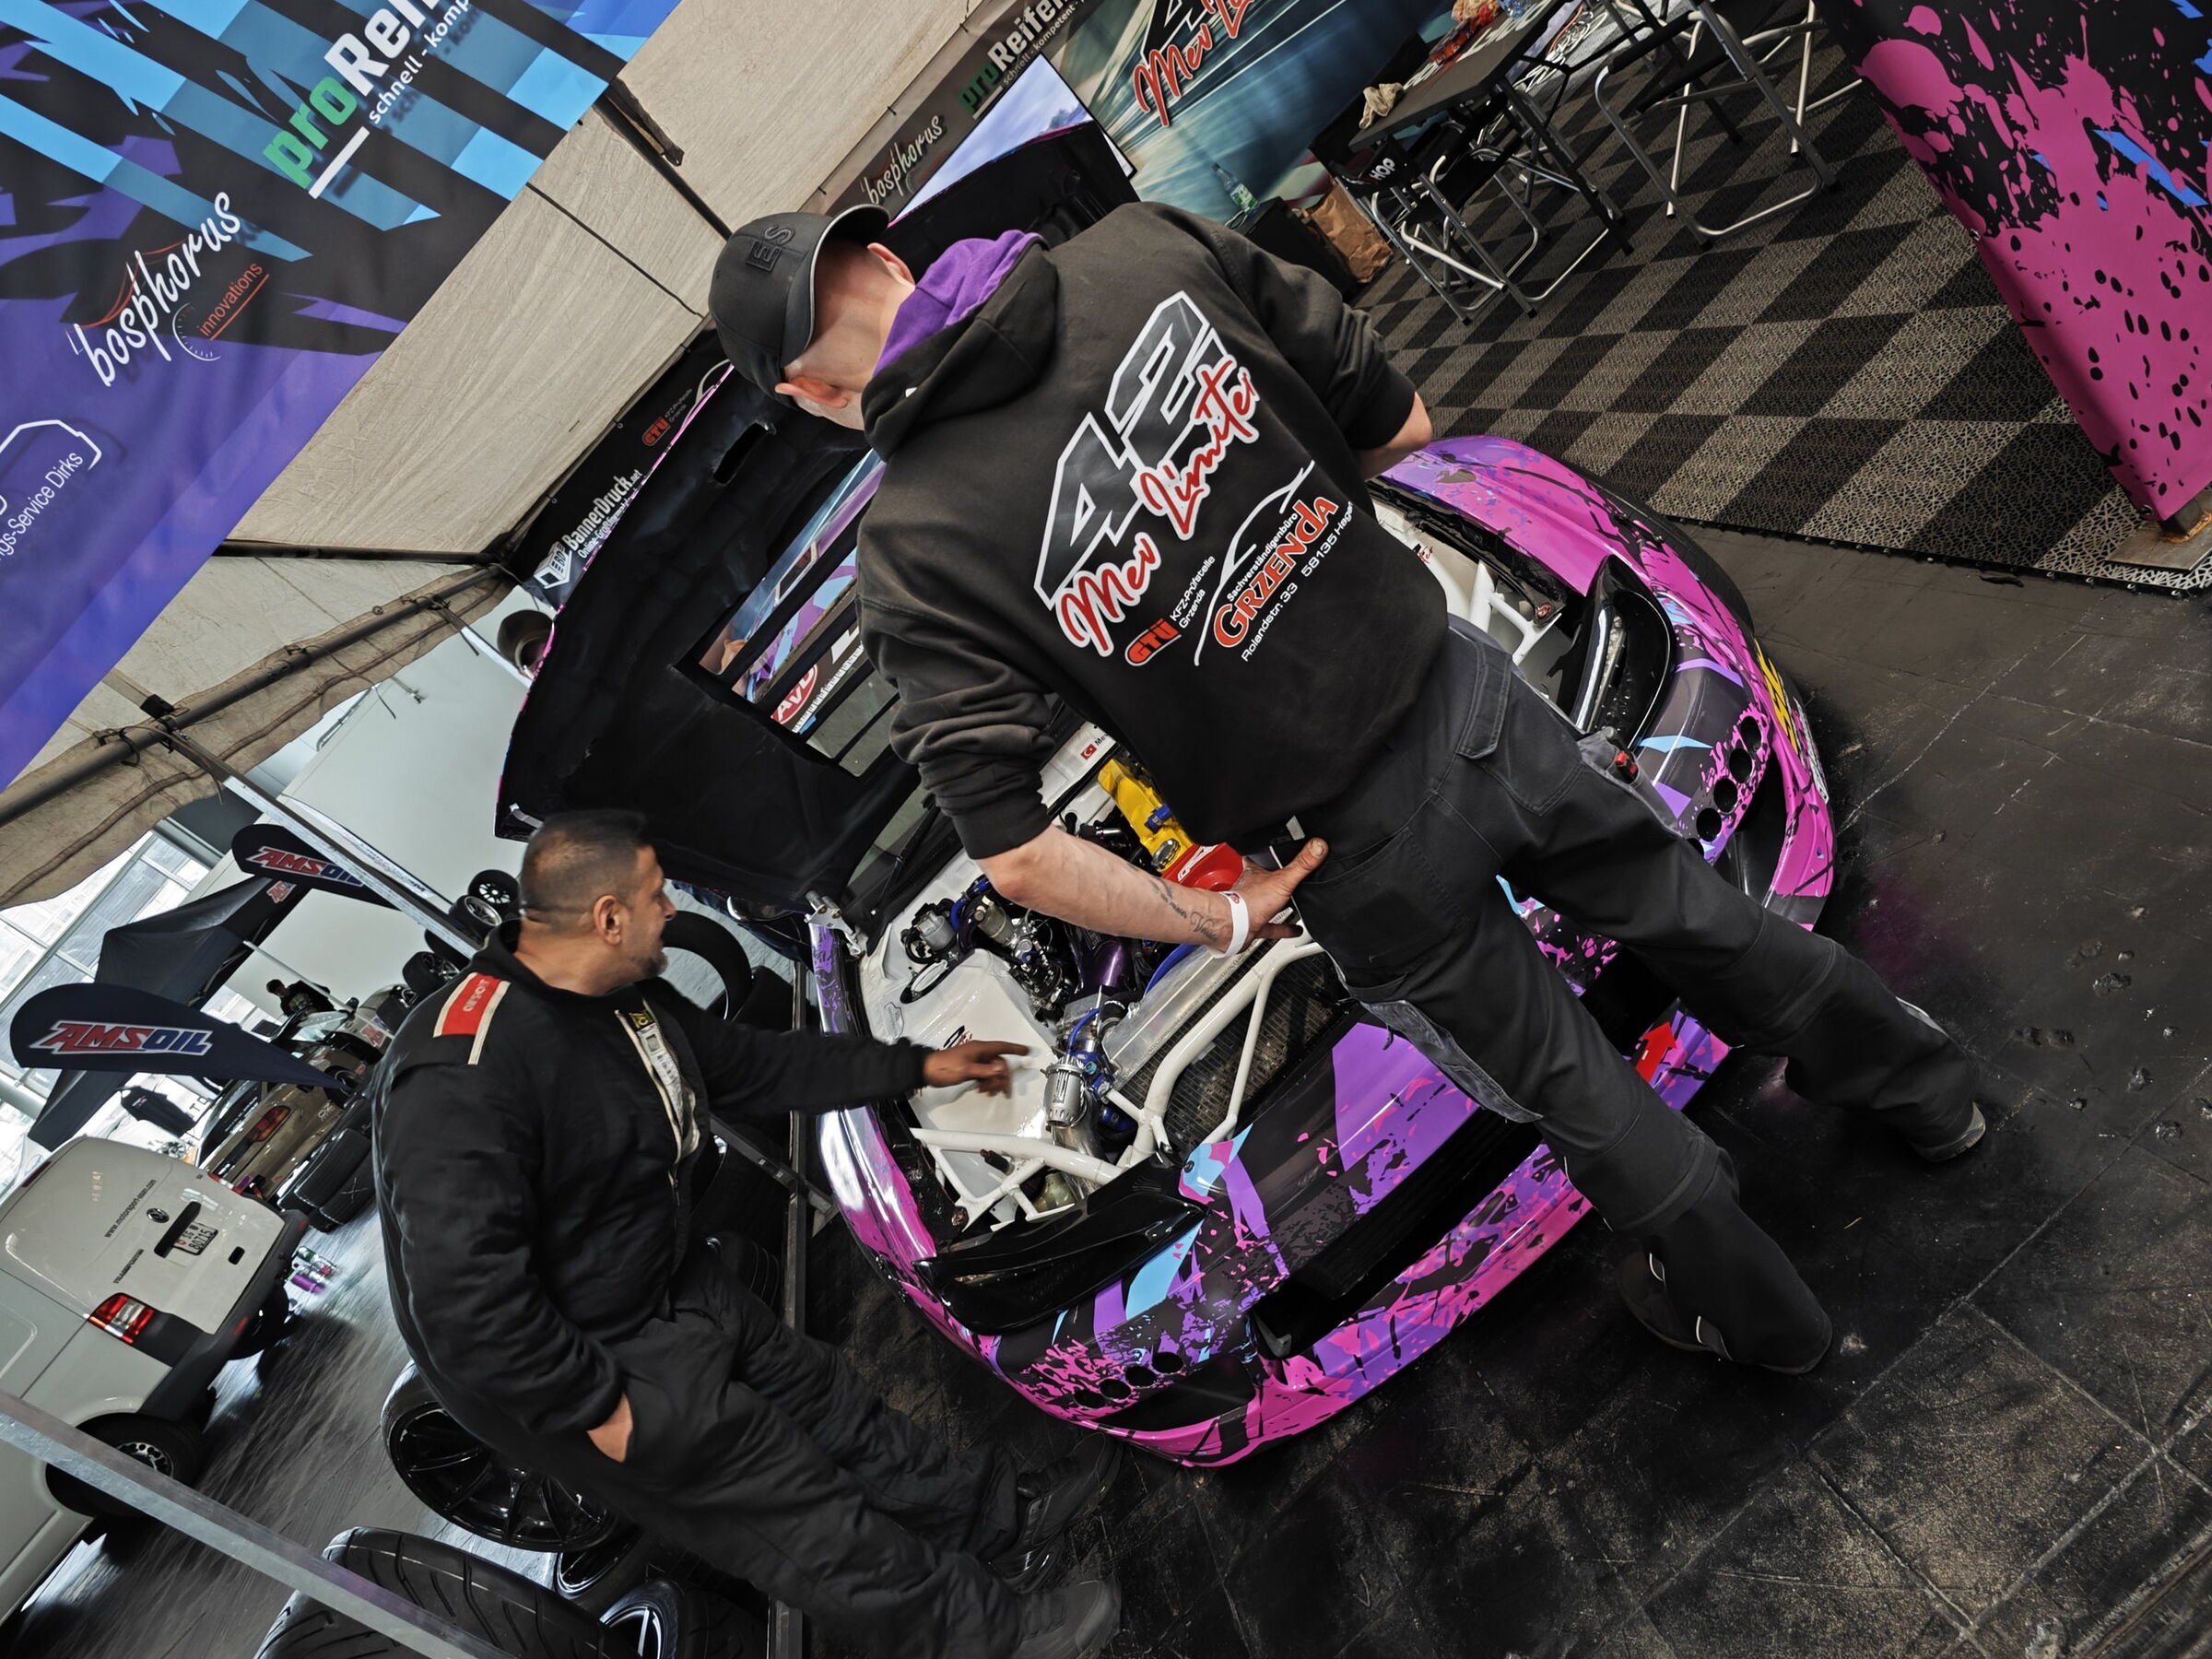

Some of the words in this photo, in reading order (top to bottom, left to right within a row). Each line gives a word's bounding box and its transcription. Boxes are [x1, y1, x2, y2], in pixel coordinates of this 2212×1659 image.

[1032, 4, 1077, 52] kompetent
[263, 0, 441, 190] proRei
[369, 55, 423, 124] schnell
[196, 263, 263, 337] innovations
[0, 486, 55, 561] gs-Service
[45, 452, 84, 488] Dirks
[1170, 556, 1216, 621] KFZ-Prüfstelle
[1227, 512, 1299, 602] Sachverständigenbüro
[1280, 582, 1299, 603] 33
[1300, 532, 1338, 578] 58135
[1179, 589, 1206, 629] Grzenda
[33, 1020, 213, 1056] AMSOIL
